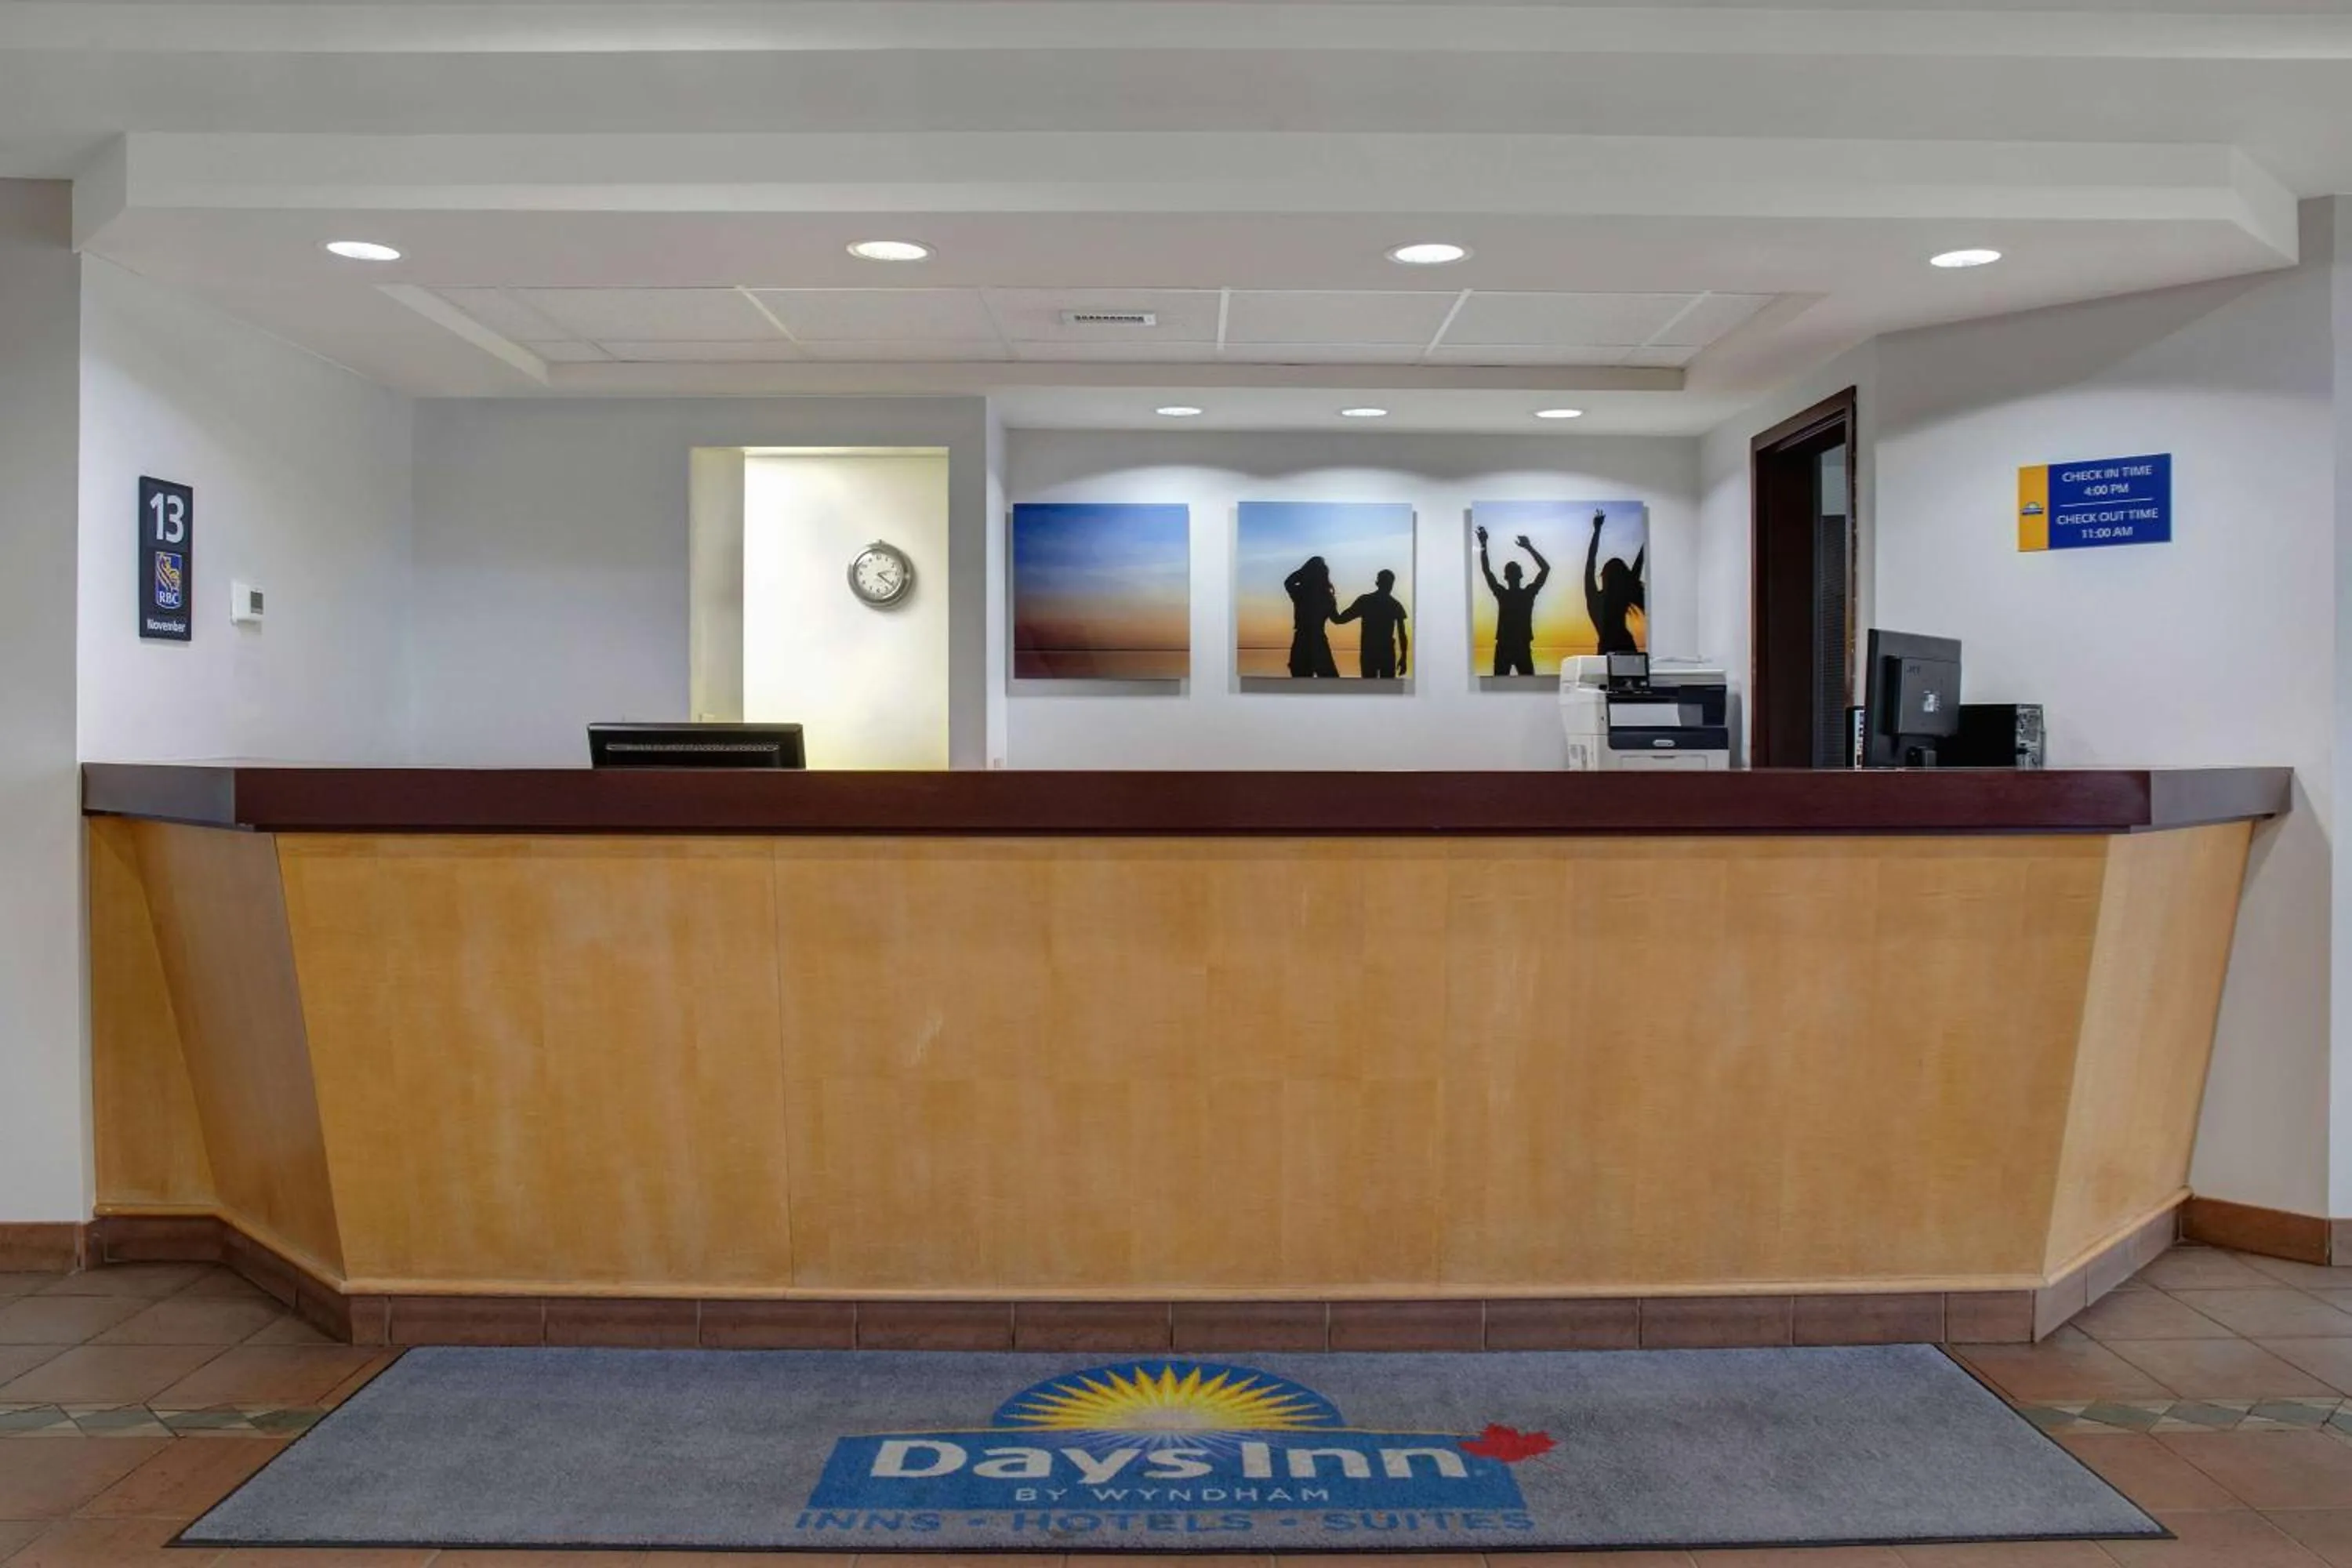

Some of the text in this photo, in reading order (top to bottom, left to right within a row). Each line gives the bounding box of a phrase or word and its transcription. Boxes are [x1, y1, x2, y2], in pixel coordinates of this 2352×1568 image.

[2062, 465, 2153, 482] CHECK IN TIME
[2084, 483, 2129, 496] 4:00 PM
[150, 492, 185, 543] 13
[2056, 508, 2158, 525] CHECK OUT TIME
[2082, 526, 2133, 539] 11:00 AM
[159, 590, 180, 604] RBC
[147, 618, 186, 633] November
[869, 1439, 1468, 1485] Days Inn
[1014, 1488, 1330, 1501] BY WYNDHAM
[795, 1511, 1535, 1533] INNS HOTELS SUITES
